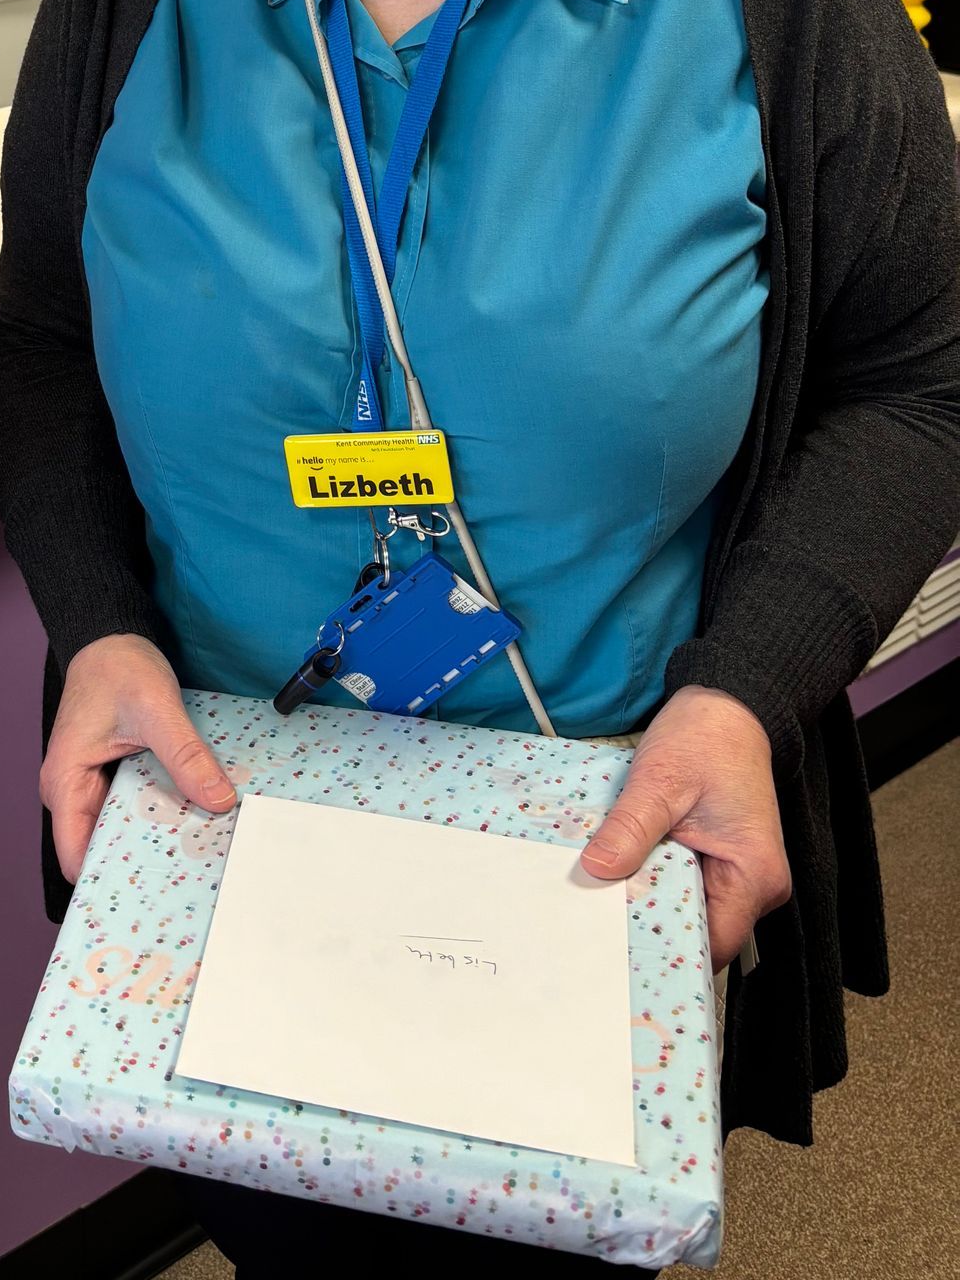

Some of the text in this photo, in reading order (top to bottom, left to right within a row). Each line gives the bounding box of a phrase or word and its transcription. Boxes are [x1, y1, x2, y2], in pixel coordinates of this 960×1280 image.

[336, 440, 352, 448] Kent
[353, 439, 391, 448] Community
[417, 435, 440, 444] NHS
[325, 457, 337, 465] my
[308, 472, 435, 499] Lizbeth
